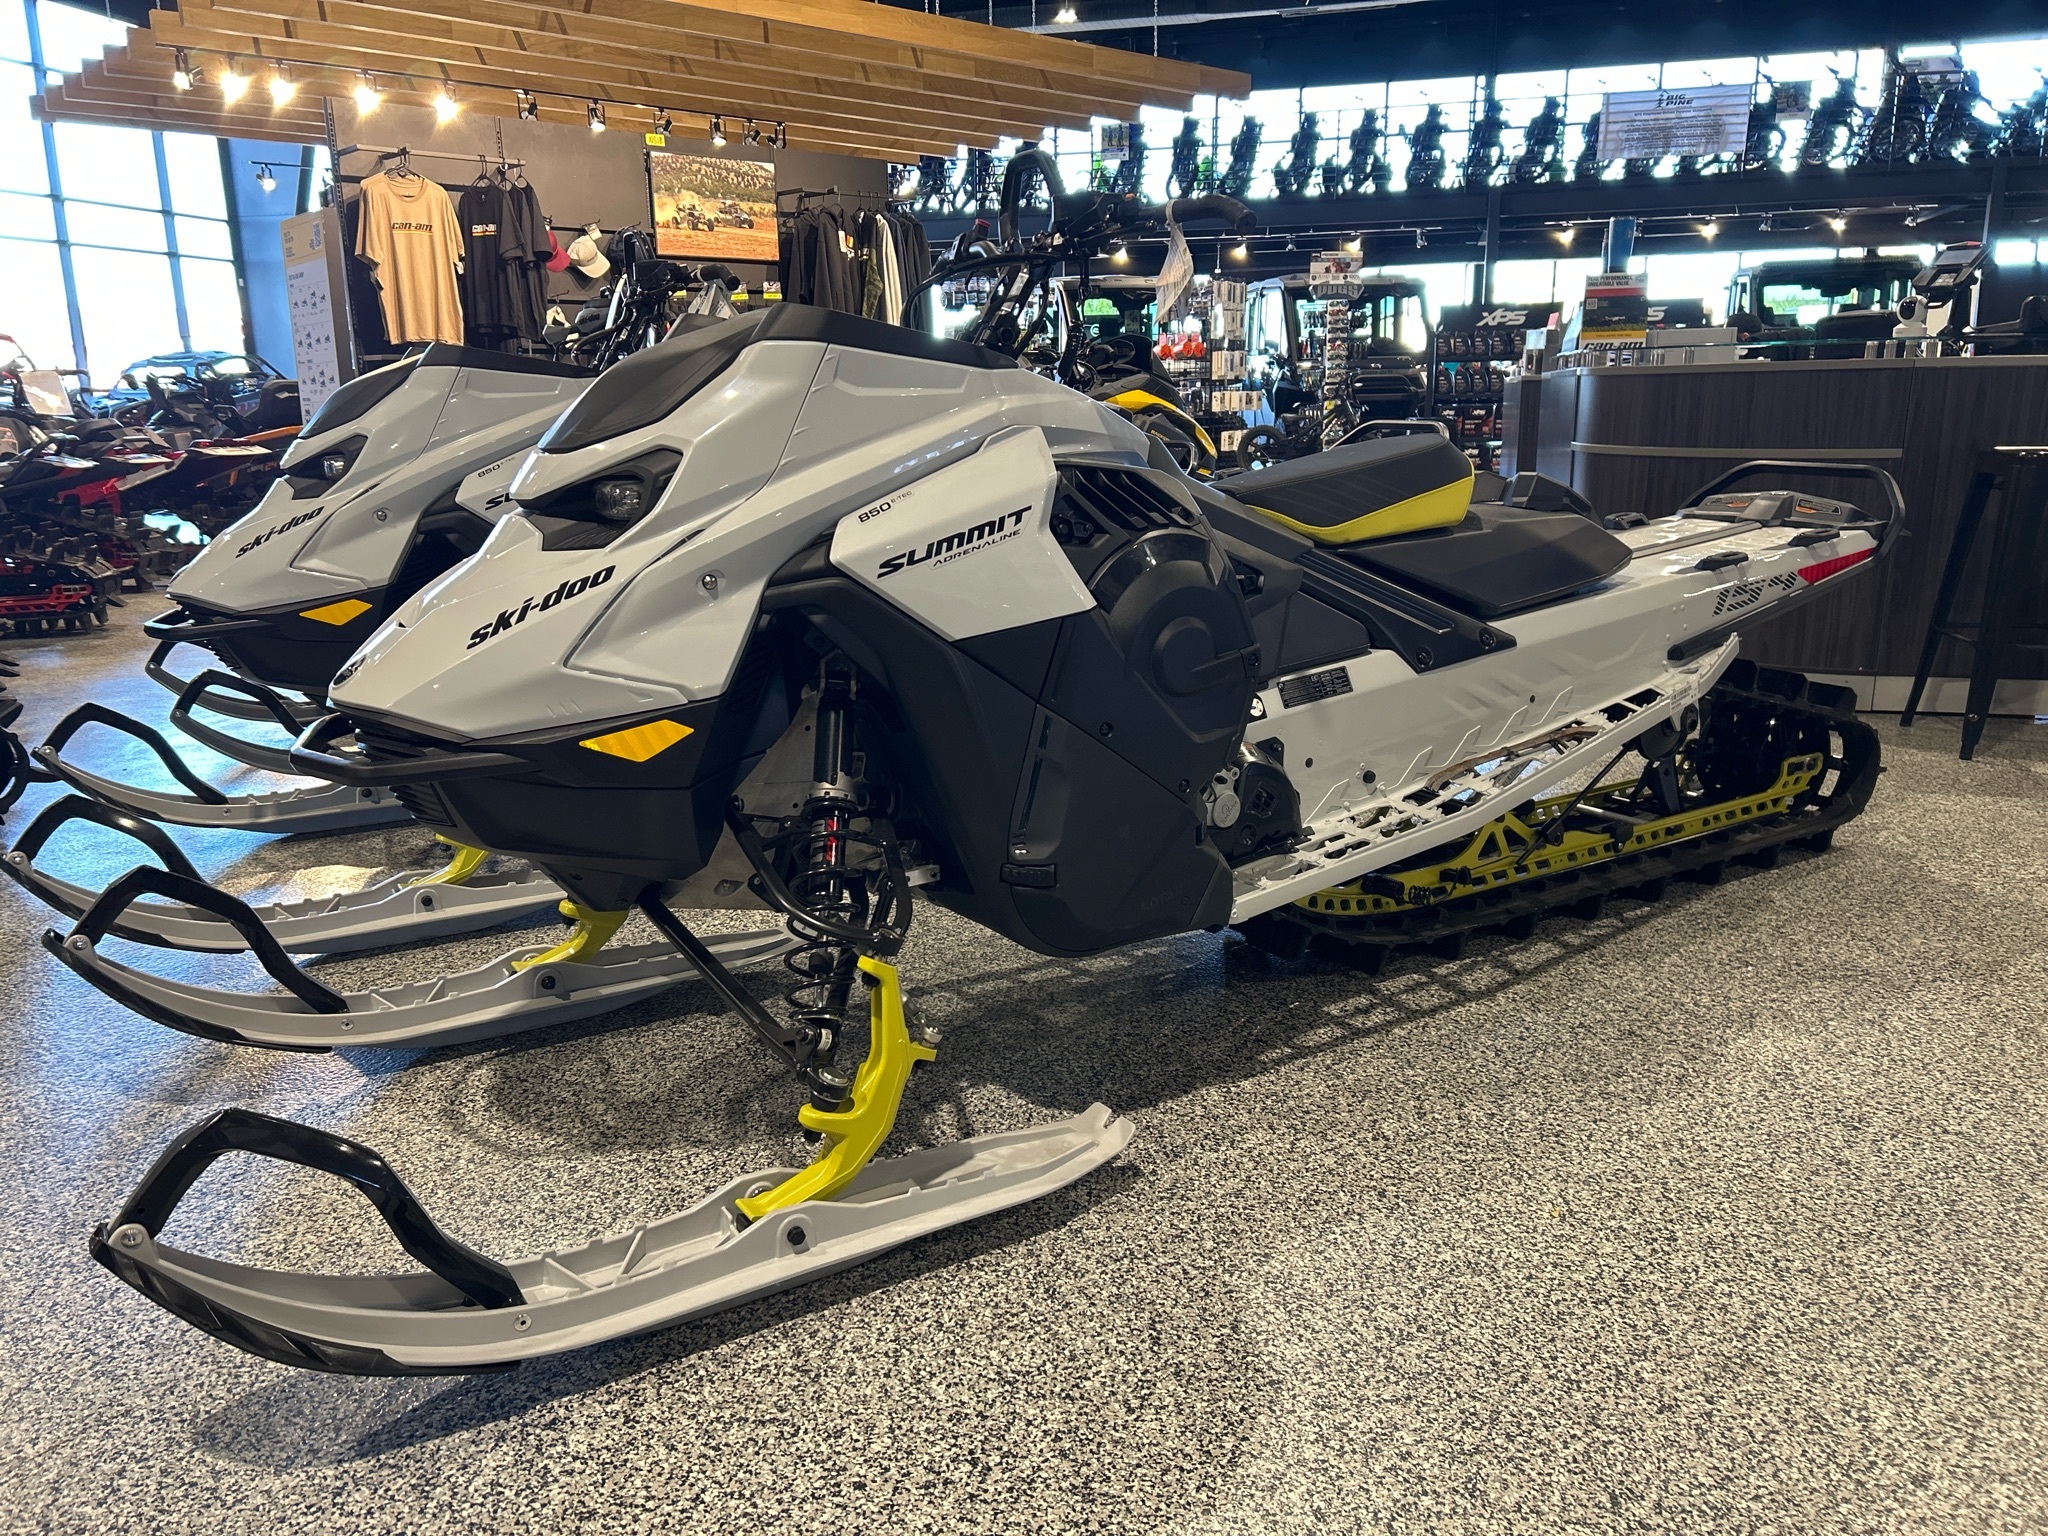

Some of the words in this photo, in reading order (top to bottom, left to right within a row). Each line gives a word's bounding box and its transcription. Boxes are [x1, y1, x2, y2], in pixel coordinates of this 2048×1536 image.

[391, 222, 433, 232] can-am
[1475, 308, 1530, 327] XPS
[476, 463, 501, 479] 850
[857, 501, 892, 523] 850
[890, 490, 913, 504] E-TEC
[235, 505, 325, 559] ski-doo
[876, 504, 1033, 579] SUMMIT
[932, 528, 1022, 568] ADRENALINE
[466, 564, 617, 650] ski-doo
